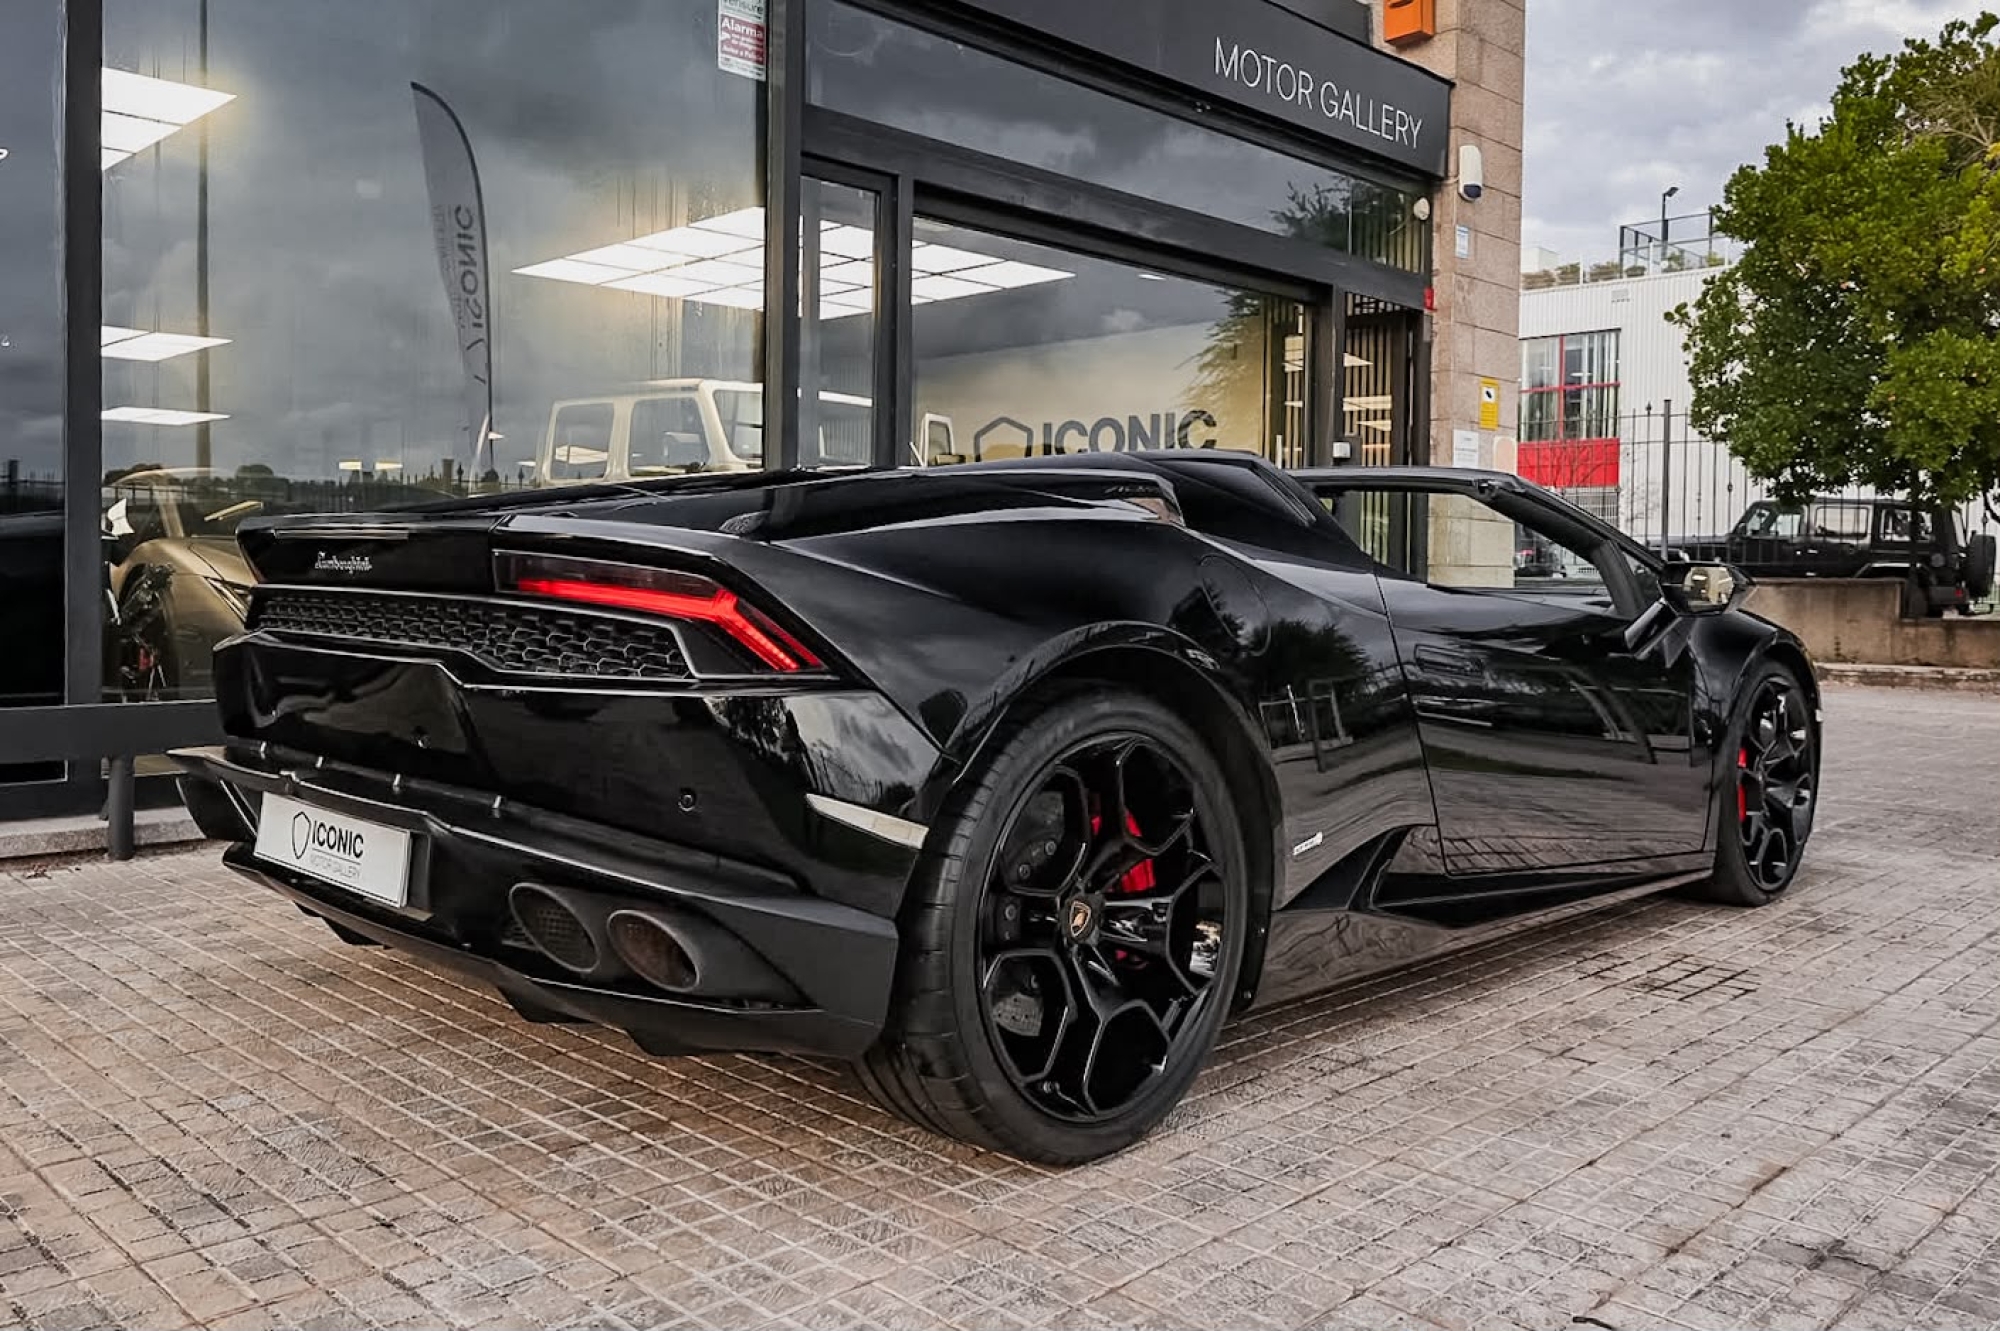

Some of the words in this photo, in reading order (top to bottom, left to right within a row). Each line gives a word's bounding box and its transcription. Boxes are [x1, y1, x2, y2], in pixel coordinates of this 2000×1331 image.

[721, 17, 763, 38] Alarma
[1215, 36, 1314, 110] MOTOR
[1320, 81, 1423, 149] GALLERY
[1043, 410, 1217, 456] ICONIC
[312, 820, 364, 858] ICONIC
